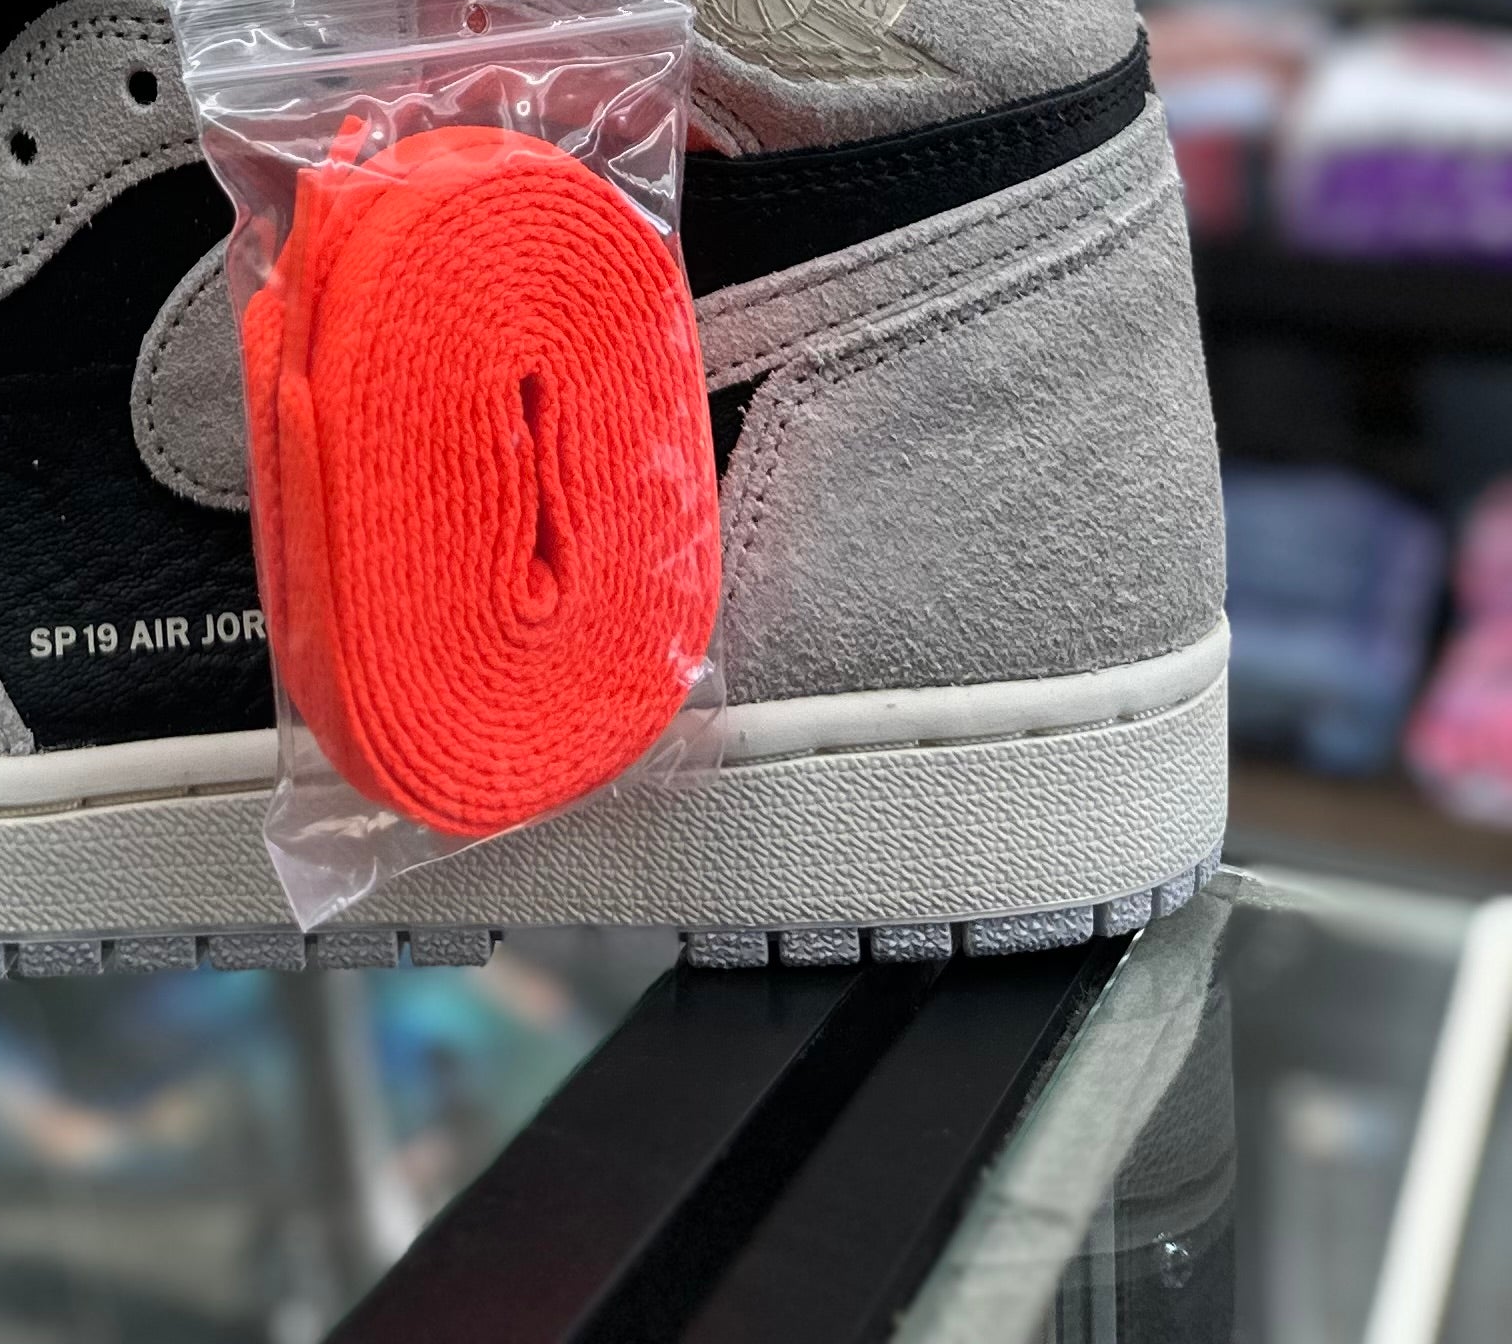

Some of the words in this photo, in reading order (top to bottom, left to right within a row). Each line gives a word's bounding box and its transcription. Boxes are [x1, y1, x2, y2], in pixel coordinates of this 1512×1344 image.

[29, 625, 77, 658] SP
[82, 622, 118, 653] 19
[130, 616, 191, 650] AIR
[201, 609, 267, 645] JOR
